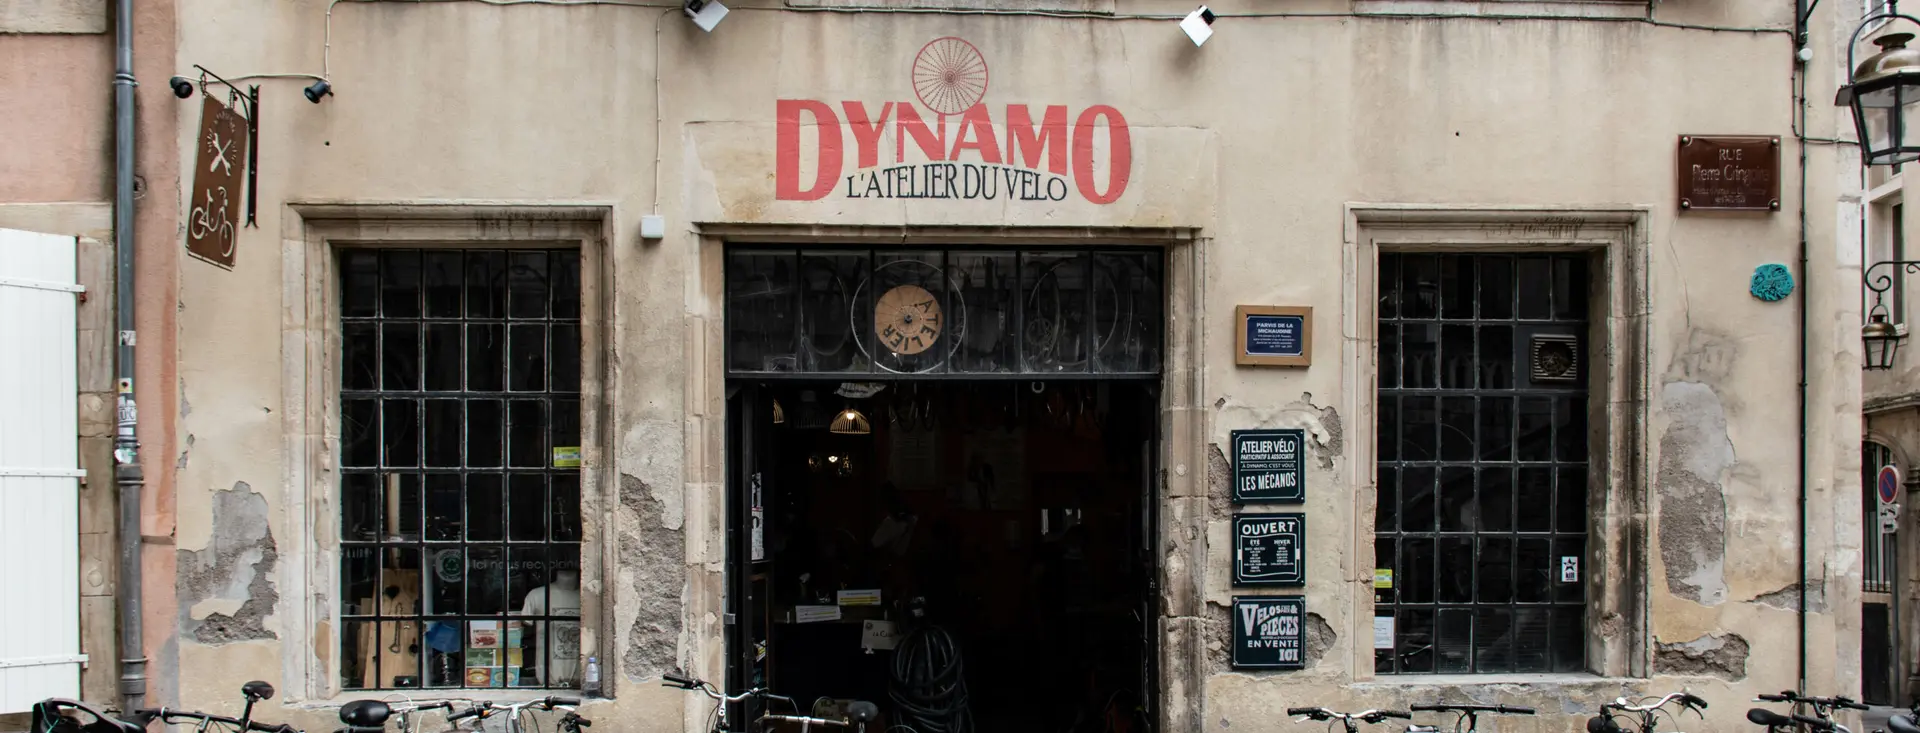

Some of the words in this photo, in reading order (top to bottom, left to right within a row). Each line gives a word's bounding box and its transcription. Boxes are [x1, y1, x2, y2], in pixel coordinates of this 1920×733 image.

[775, 100, 1131, 204] DYNAMO
[1719, 148, 1742, 161] RUE
[846, 163, 959, 199] L'ATELIER
[963, 164, 999, 200] DU
[1002, 167, 1067, 201] VELO
[1240, 440, 1273, 453] ATELIER
[1273, 438, 1295, 453] VÉLO
[1241, 475, 1256, 491] LES
[1258, 472, 1296, 490] MÉCANOS
[1242, 521, 1296, 535] OUVERT
[490, 561, 519, 570] nos
[1290, 604, 1298, 614] &
[1260, 615, 1299, 636] PIECES
[1247, 640, 1261, 648] EN
[1264, 640, 1298, 648] VENTE
[1279, 648, 1298, 661] ICI
